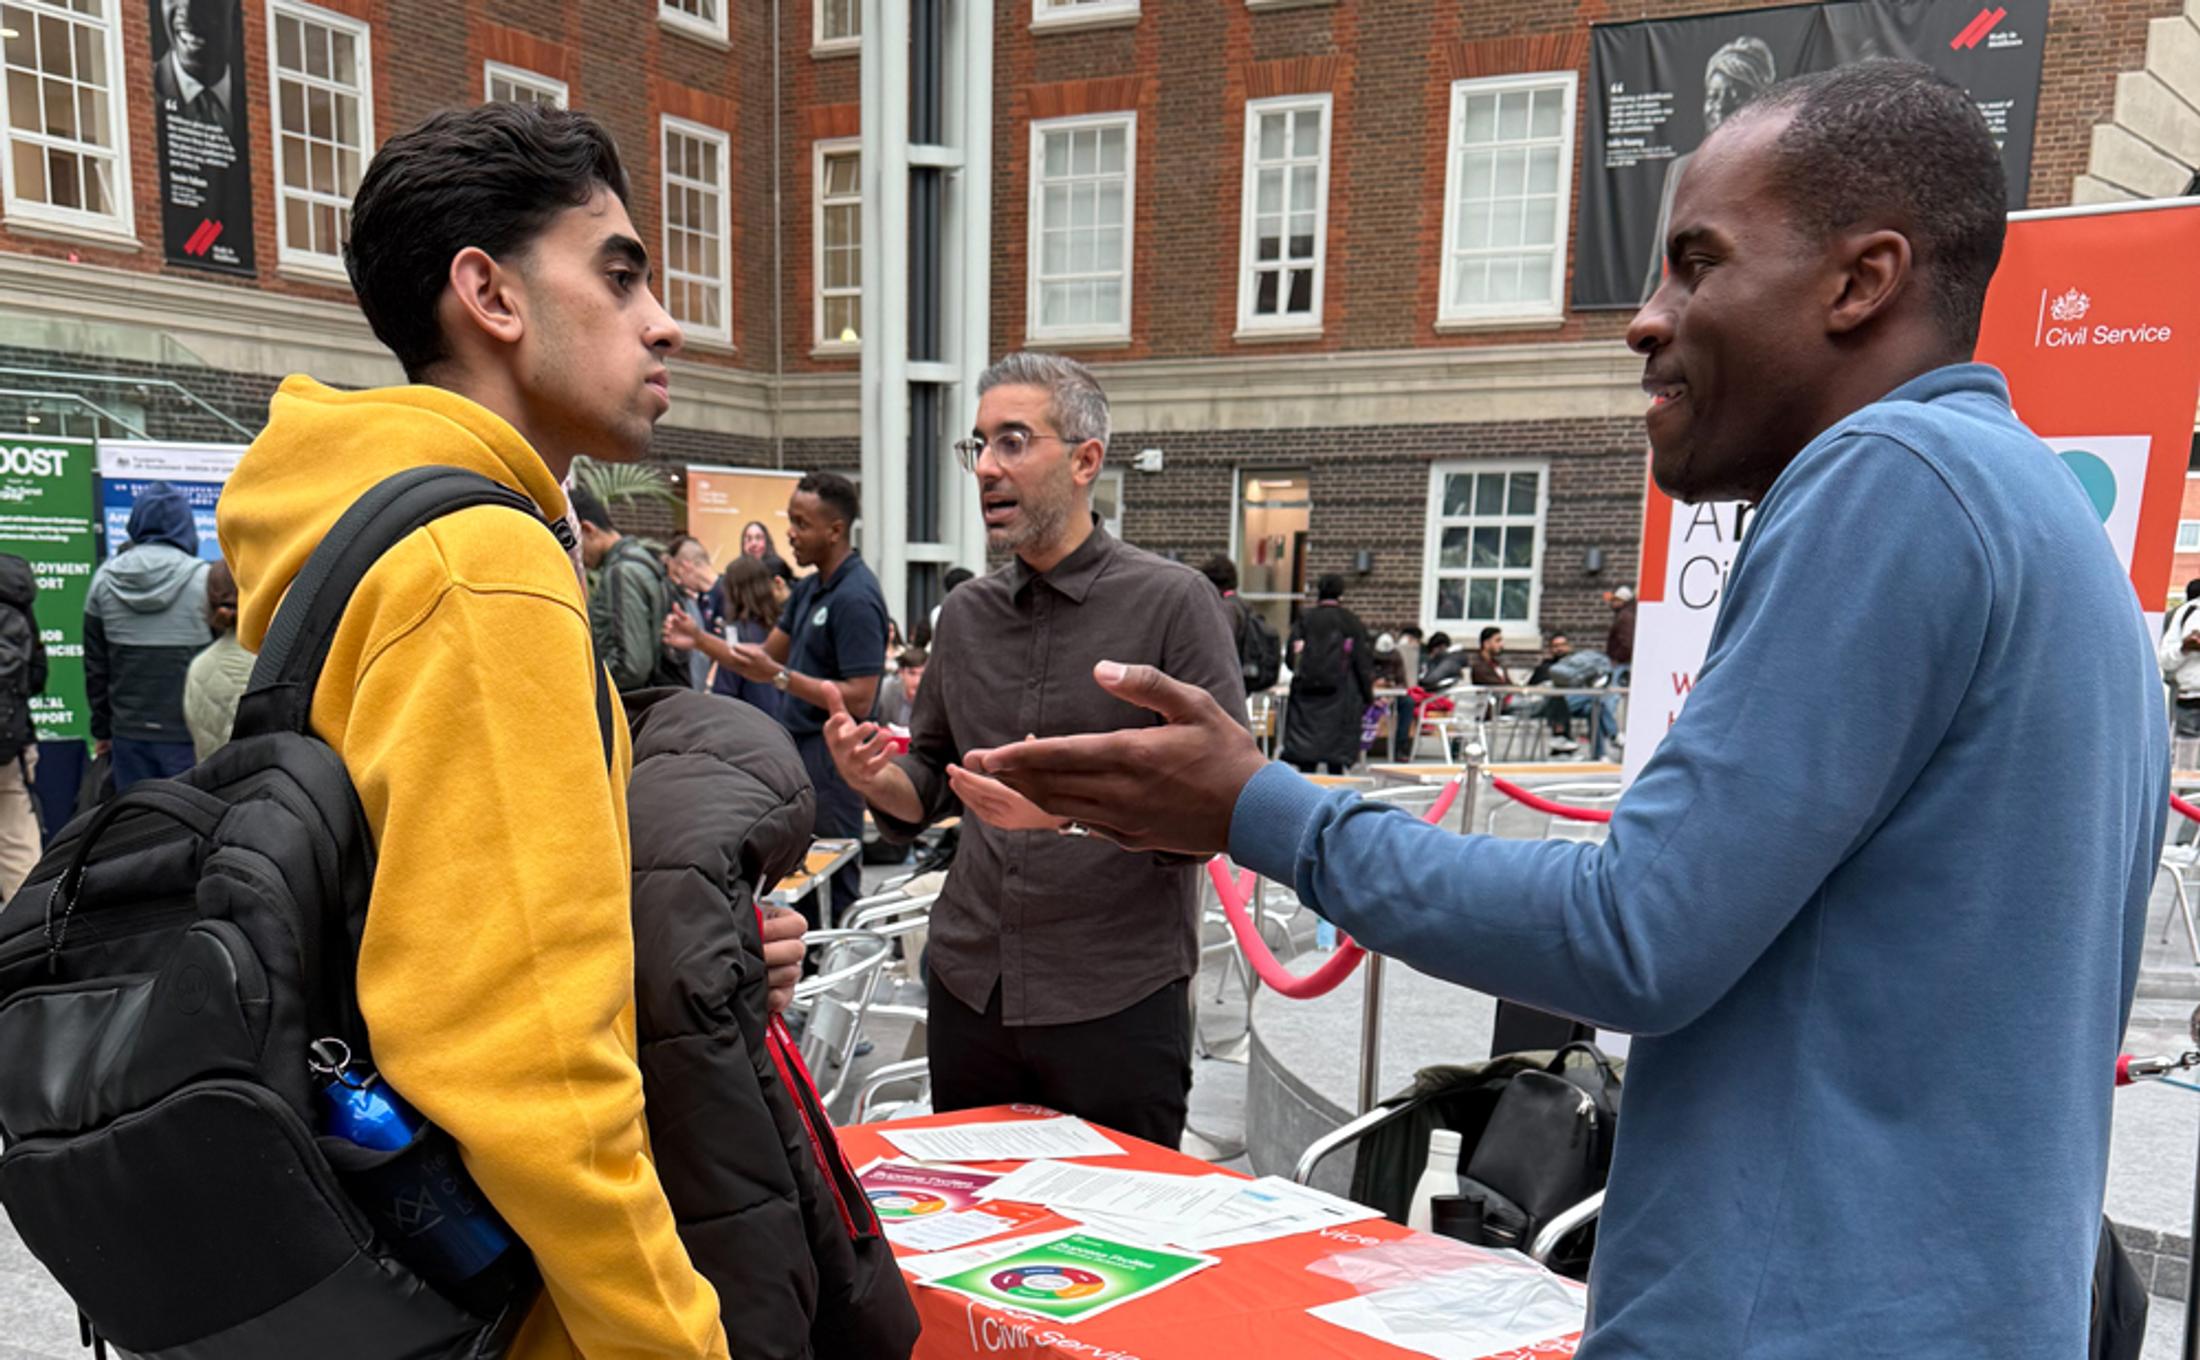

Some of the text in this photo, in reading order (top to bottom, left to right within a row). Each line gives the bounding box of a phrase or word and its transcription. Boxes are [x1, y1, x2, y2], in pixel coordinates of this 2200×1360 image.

[2045, 323, 2171, 347] Civil Service
[0, 447, 69, 477] OOST
[31, 562, 91, 575] LOYMENT
[36, 577, 65, 589] ORT
[46, 644, 85, 657] NCIES
[30, 711, 74, 724] PPORT
[1318, 1227, 1381, 1248] vice
